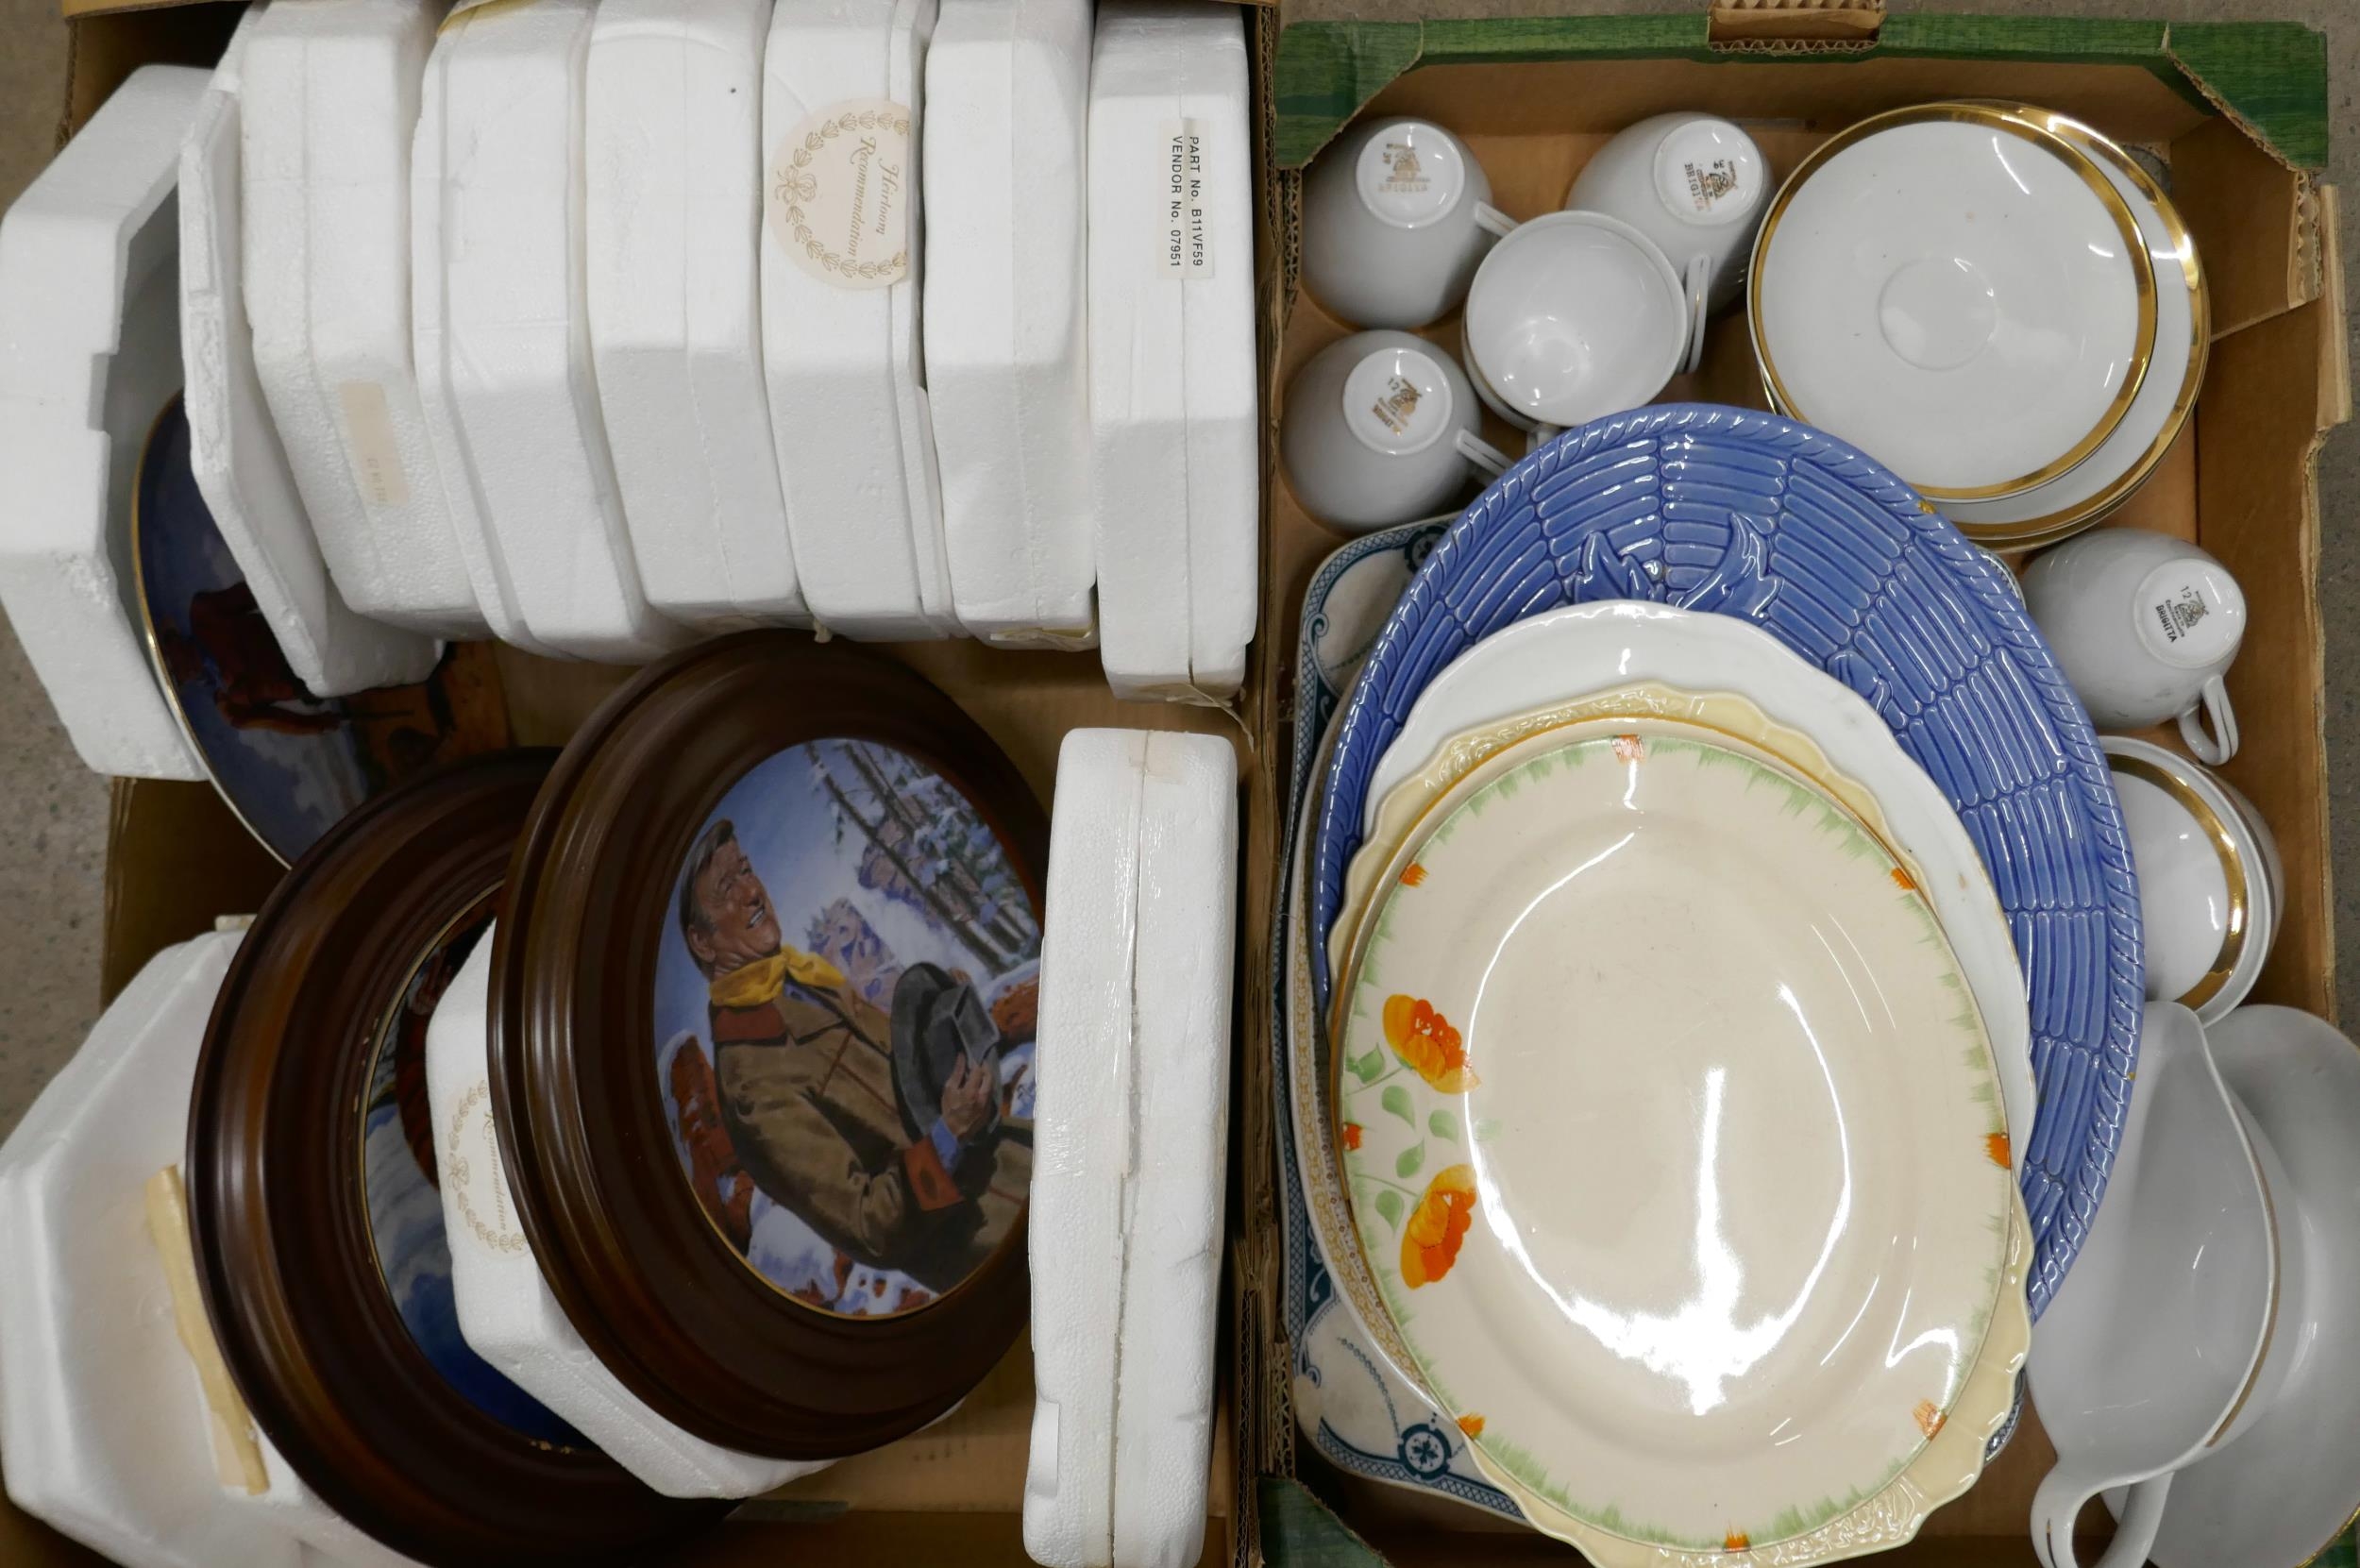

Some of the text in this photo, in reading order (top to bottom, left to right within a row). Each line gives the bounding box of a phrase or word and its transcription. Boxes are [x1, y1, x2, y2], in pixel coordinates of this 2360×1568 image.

[849, 137, 877, 256] Recommendation
[875, 159, 900, 235] Heirloom
[1170, 135, 1183, 266] VENDOR No. 07951
[1188, 136, 1204, 266] PART No. B11VF59
[2155, 604, 2177, 642] BRIGITTA
[2180, 585, 2192, 599] 12
